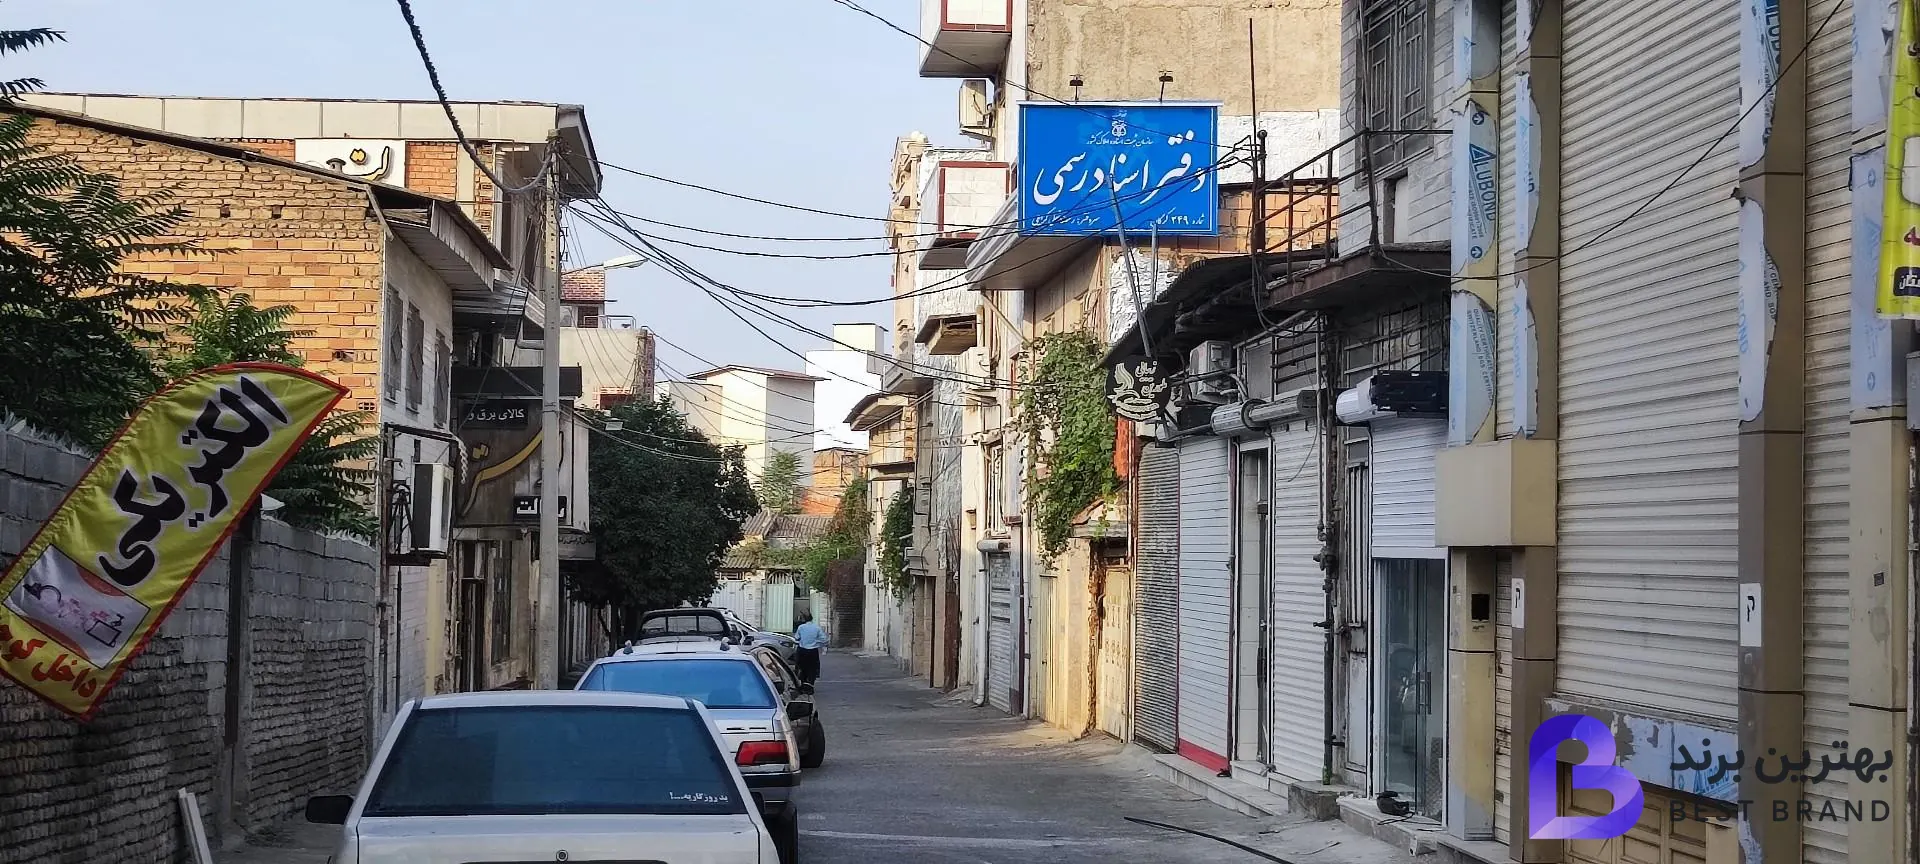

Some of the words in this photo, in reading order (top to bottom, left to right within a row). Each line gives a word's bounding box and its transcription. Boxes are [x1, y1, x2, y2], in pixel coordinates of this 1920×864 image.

[1033, 152, 1089, 205] رسمی
[1089, 152, 1150, 193] اسناد
[1139, 130, 1206, 204] دفتر
[466, 411, 475, 421] و
[476, 408, 497, 421] برق
[498, 408, 525, 420] کالای
[98, 375, 288, 587] الکتریکی
[31, 653, 98, 698] داخل
